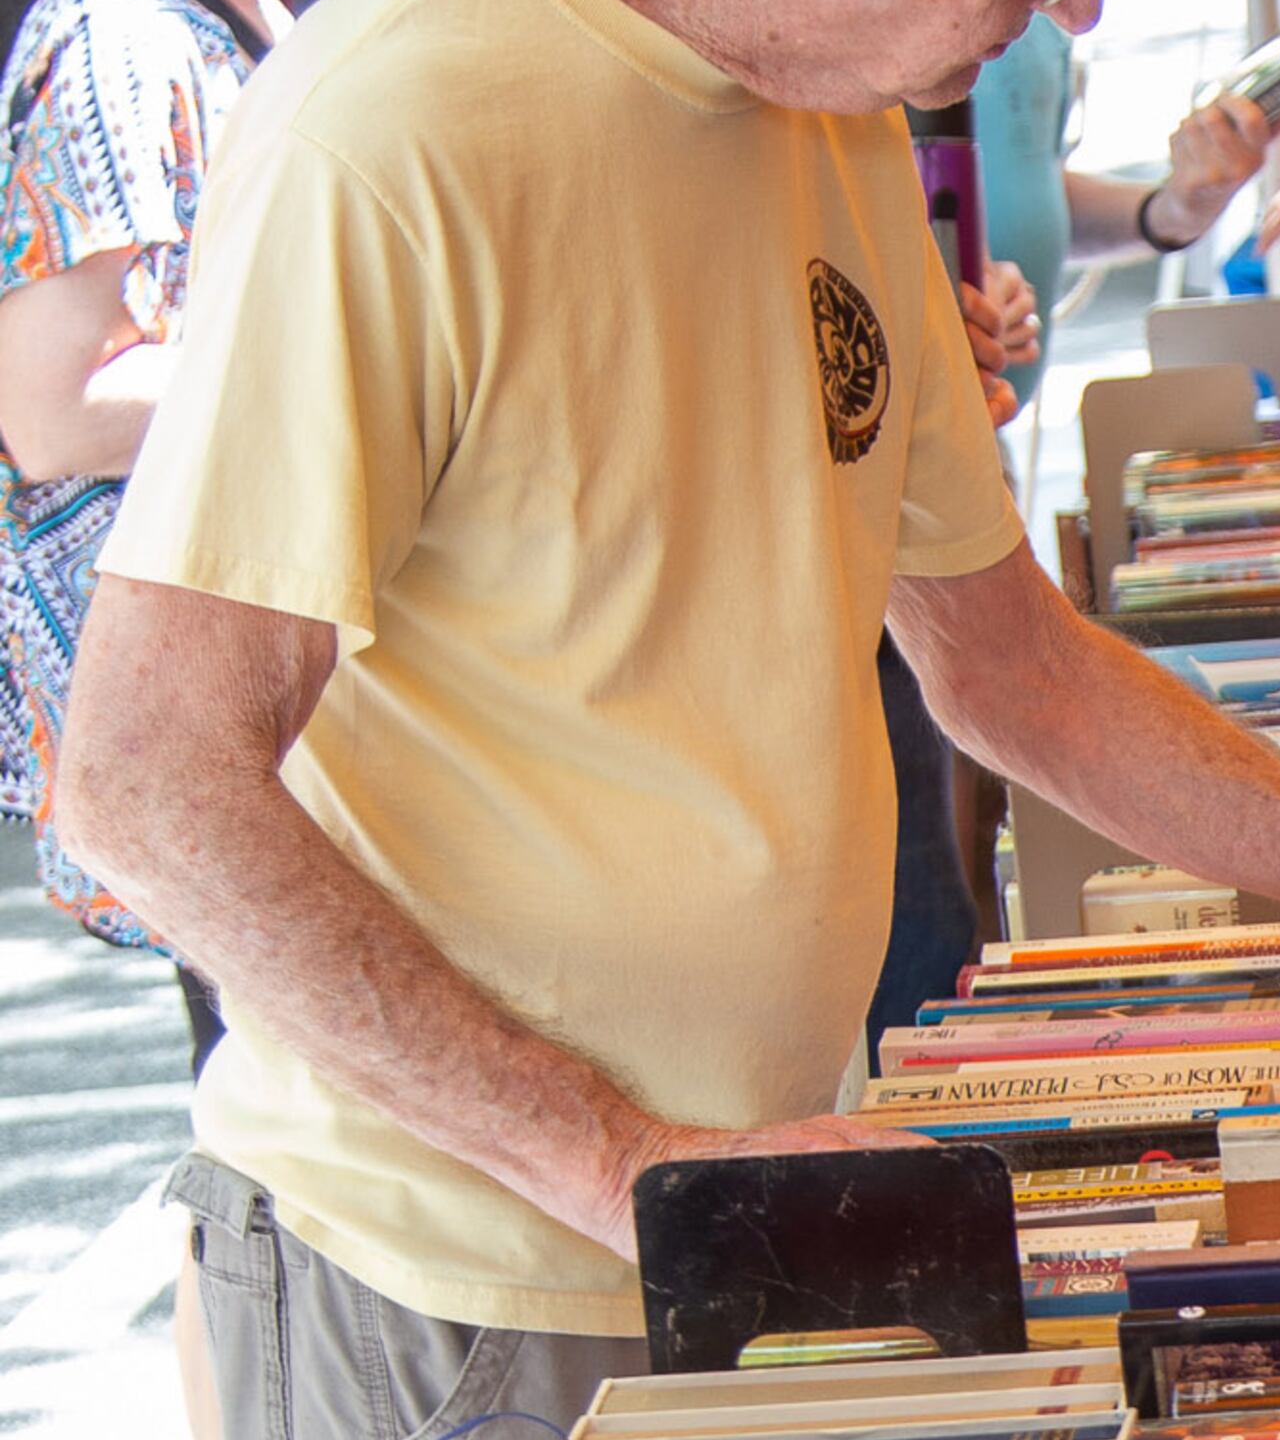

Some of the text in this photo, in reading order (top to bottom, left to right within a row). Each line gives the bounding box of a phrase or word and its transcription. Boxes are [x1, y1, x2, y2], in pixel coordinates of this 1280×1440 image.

[1185, 1065, 1248, 1087] MOST
[948, 1077, 1069, 1102] PERELMAN
[1063, 1164, 1140, 1185] LIFE
